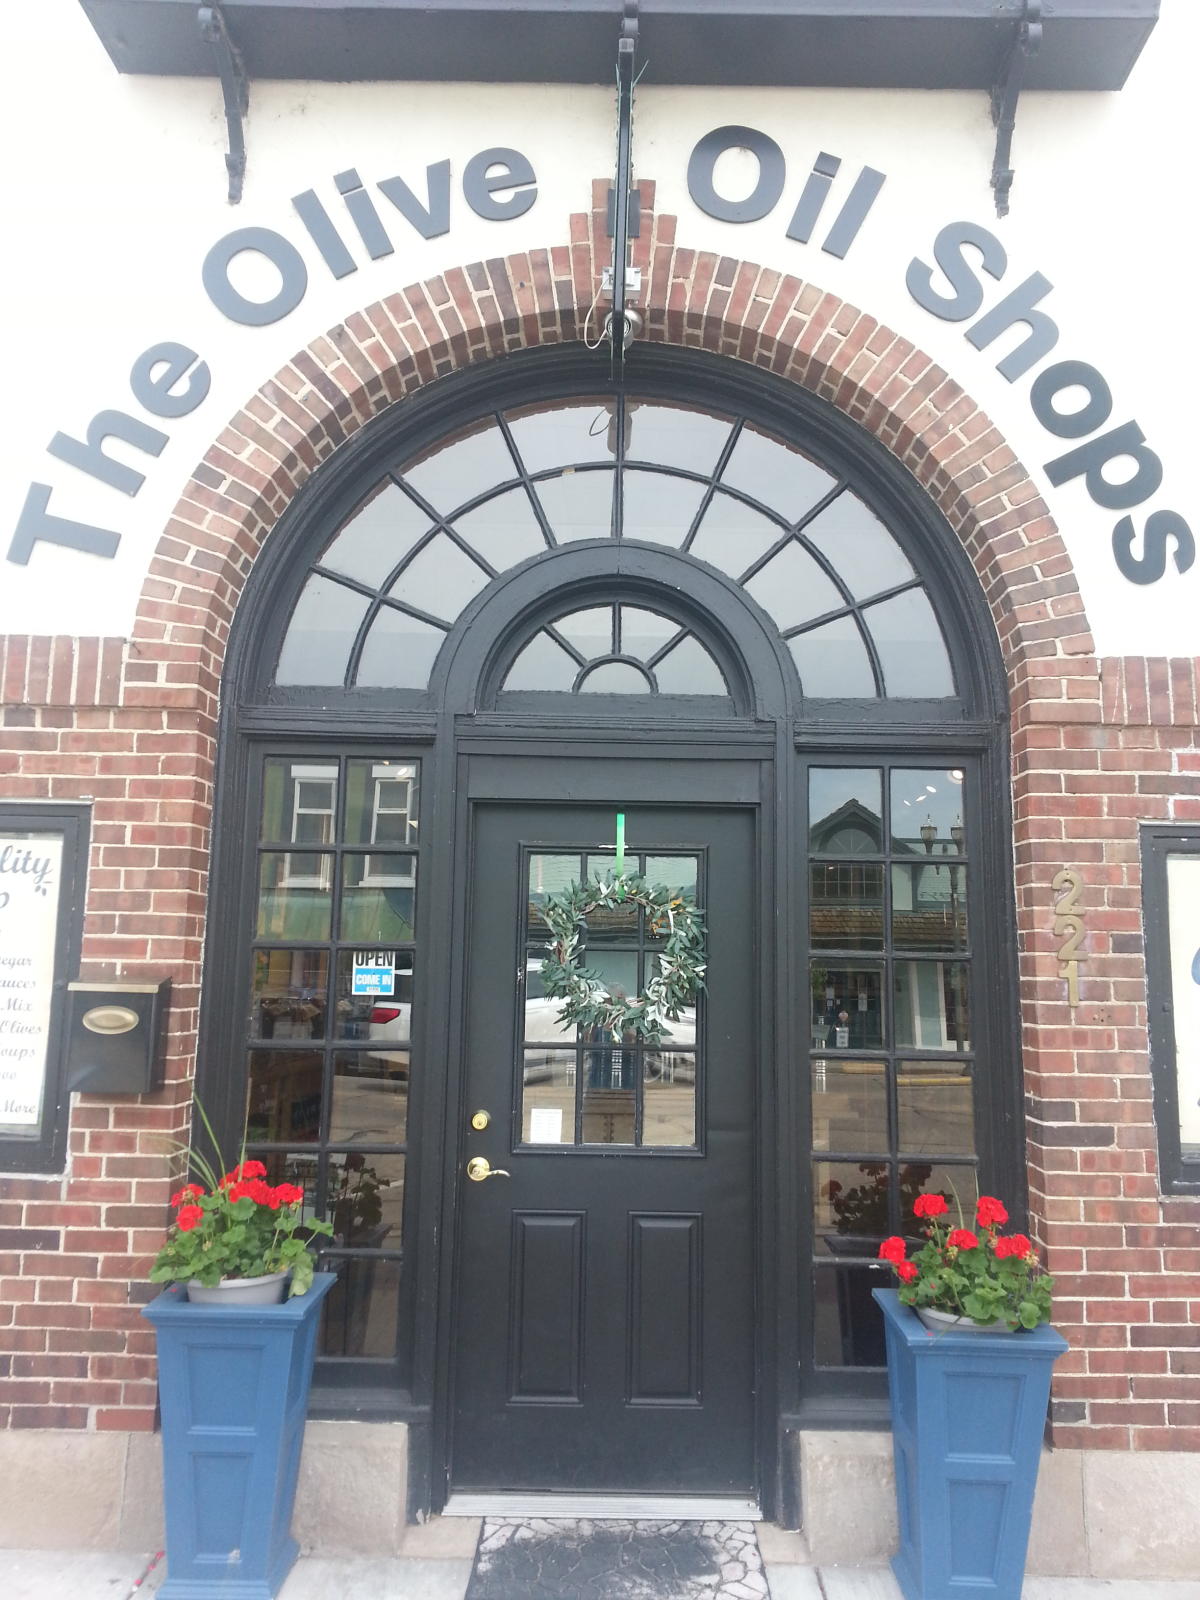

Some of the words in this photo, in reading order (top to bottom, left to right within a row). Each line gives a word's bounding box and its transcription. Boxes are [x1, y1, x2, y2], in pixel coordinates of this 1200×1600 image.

[6, 341, 211, 566] The
[201, 147, 538, 326] Olive
[687, 125, 887, 260] Oil
[905, 221, 1196, 586] Shops
[0, 845, 53, 884] lity
[1052, 868, 1088, 1007] 221
[0, 956, 32, 970] egar
[355, 950, 393, 966] OPEN
[356, 974, 381, 985] COME
[382, 974, 392, 985] IN
